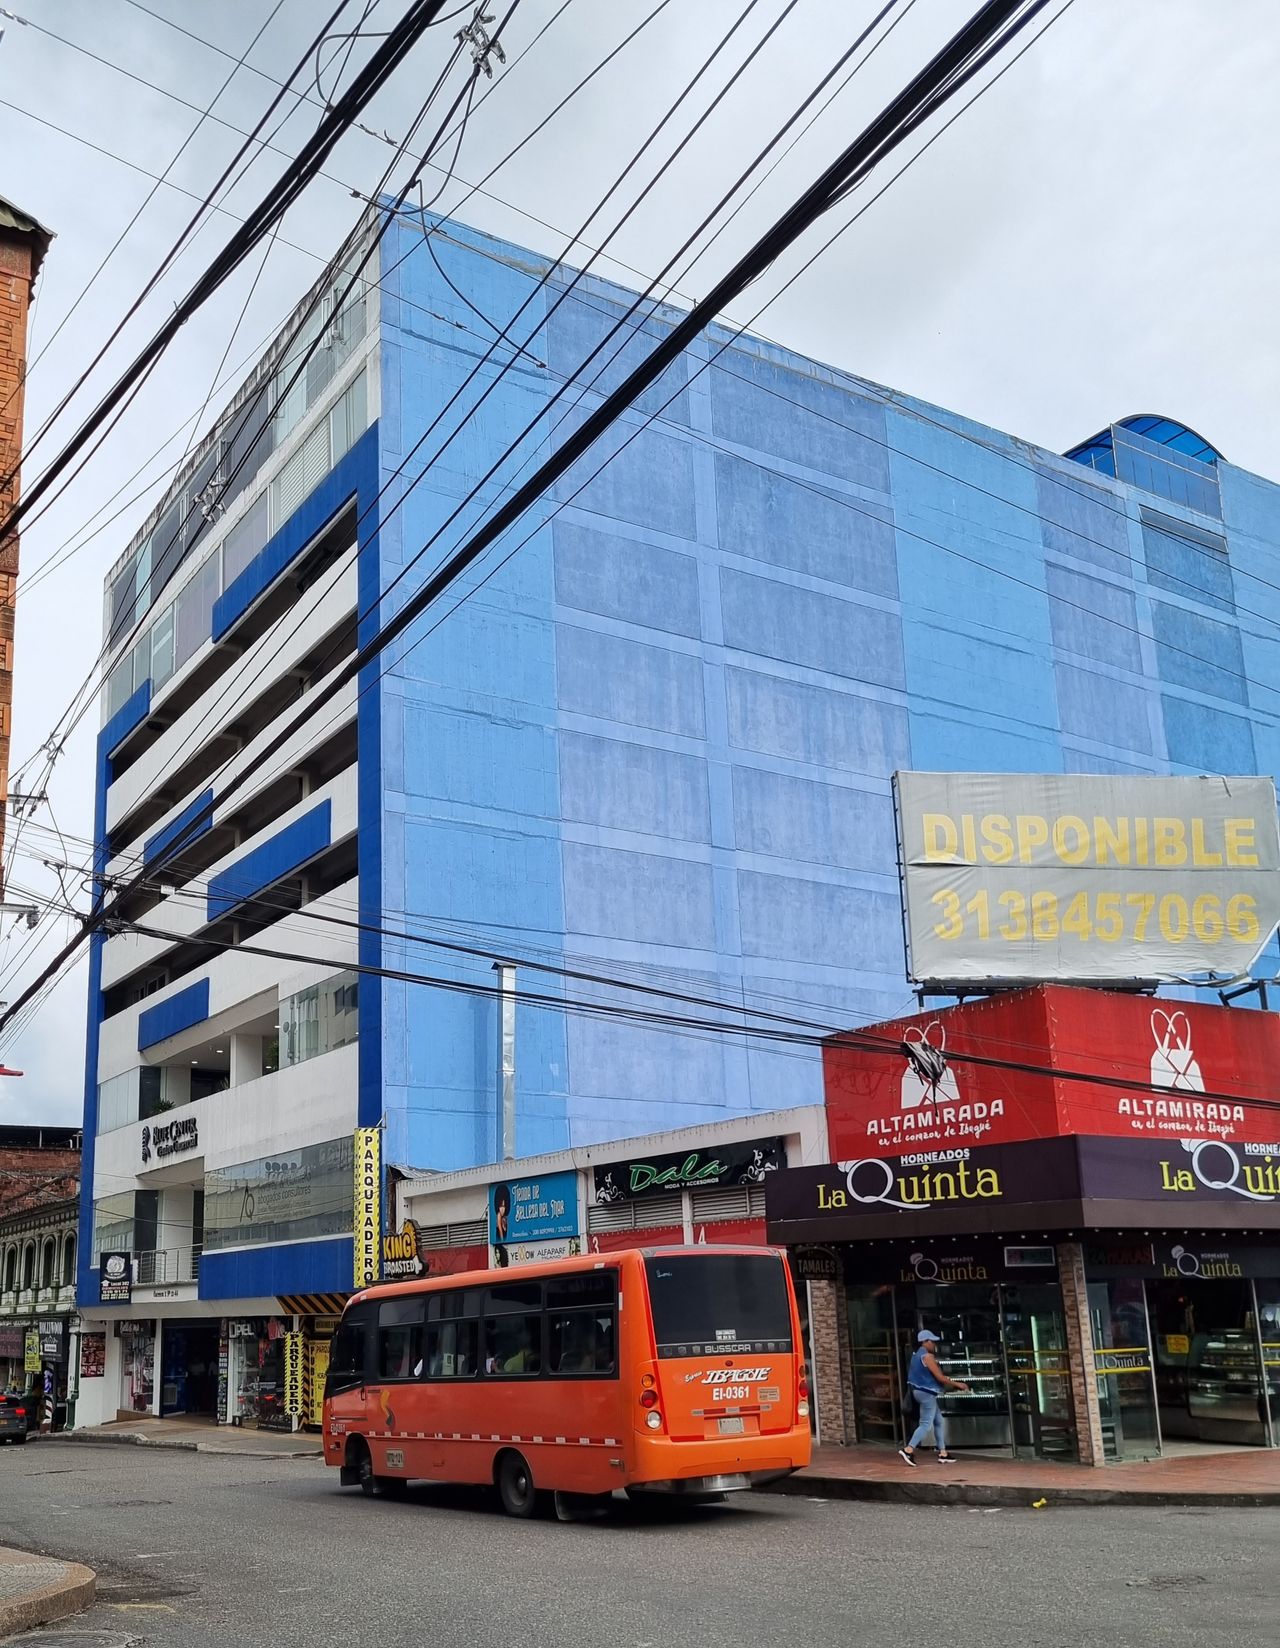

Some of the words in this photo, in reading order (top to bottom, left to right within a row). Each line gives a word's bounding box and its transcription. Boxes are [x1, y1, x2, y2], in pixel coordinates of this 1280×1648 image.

[922, 812, 1259, 866] DISPONIBLE
[931, 889, 1260, 944] 3138457066
[867, 1099, 1004, 1135] ALTAMIRADA
[1118, 1098, 1244, 1121] ALTAMIRADA
[892, 1132, 901, 1143] el
[944, 1125, 956, 1137] de
[1146, 1118, 1155, 1128] el
[1195, 1120, 1205, 1132] de
[900, 1148, 970, 1165] HORNEADOS
[1244, 1142, 1280, 1155] HORNE
[629, 1153, 728, 1192] Dala
[816, 1184, 848, 1209] La
[847, 1158, 1003, 1209] Quinta
[1159, 1161, 1196, 1192] La
[364, 1136, 374, 1280] PARQUEADERO
[383, 1232, 412, 1260] KING
[536, 1246, 566, 1257] ALFAPARF
[593, 1235, 599, 1254] 3
[384, 1260, 415, 1275] BROASTED
[797, 1258, 836, 1274] TAMALES
[901, 1269, 915, 1282] La
[915, 1259, 987, 1283] Quinta
[1163, 1263, 1178, 1277] La
[1177, 1253, 1242, 1279] Quinta
[705, 1344, 752, 1354] BUSSCAR
[1105, 1354, 1144, 1369] Quinta
[289, 1334, 299, 1413] PARQUEADERO
[713, 1385, 750, 1401] EI-0361
